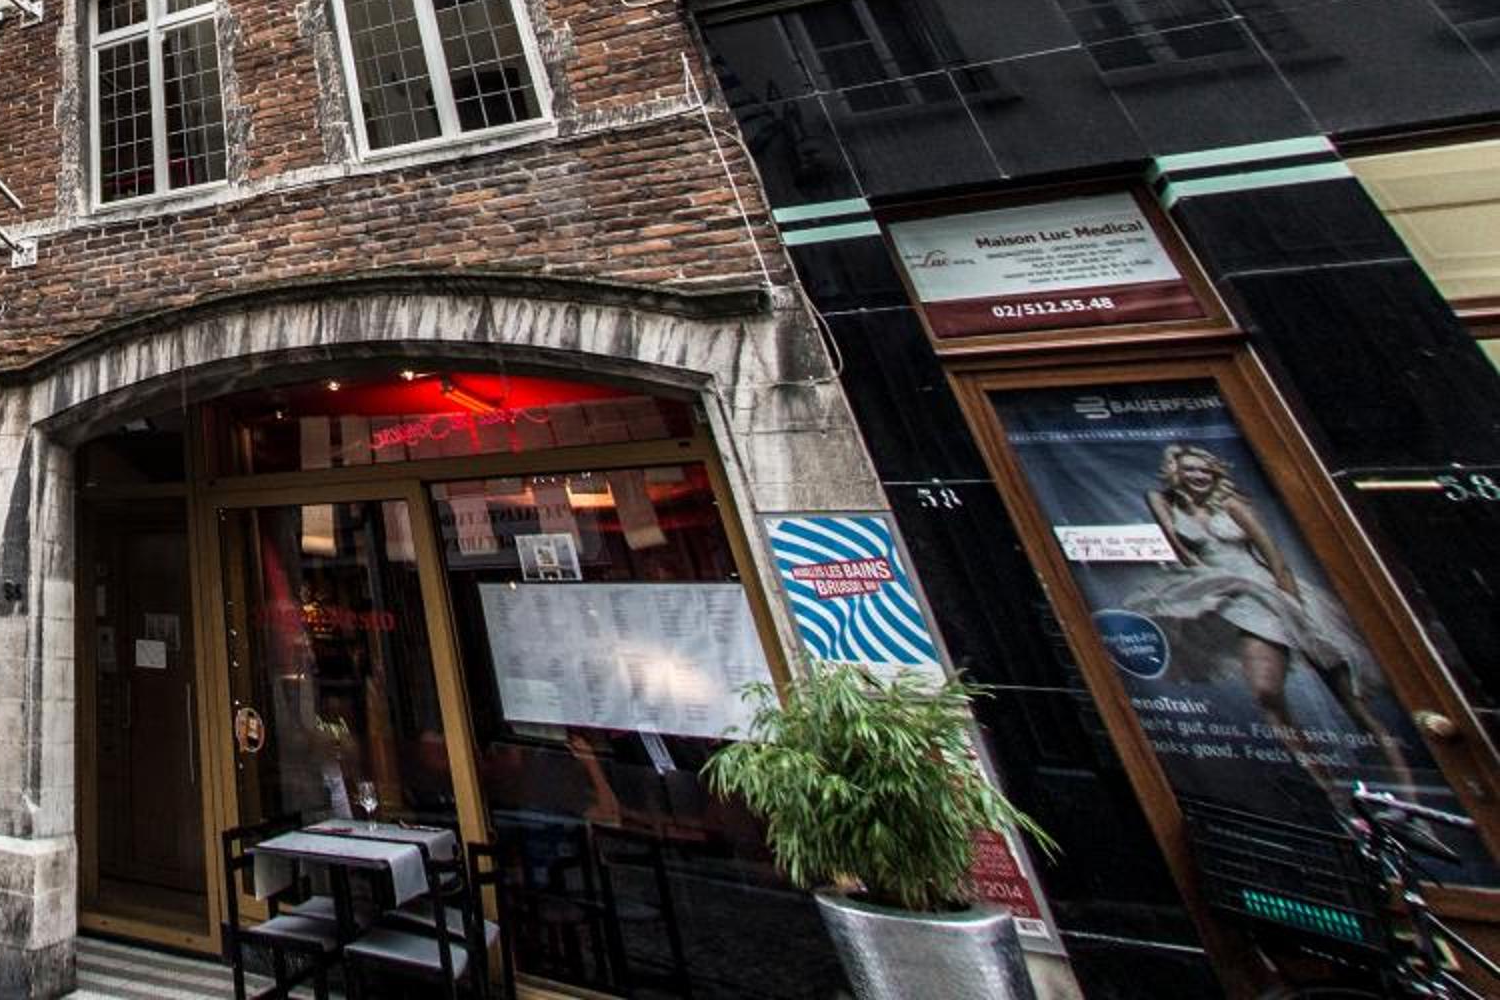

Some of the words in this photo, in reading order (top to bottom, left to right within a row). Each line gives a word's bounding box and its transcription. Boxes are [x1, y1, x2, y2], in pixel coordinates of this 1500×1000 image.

[976, 231, 1037, 249] Maison
[1039, 230, 1073, 242] Luc
[1073, 219, 1145, 240] Medical
